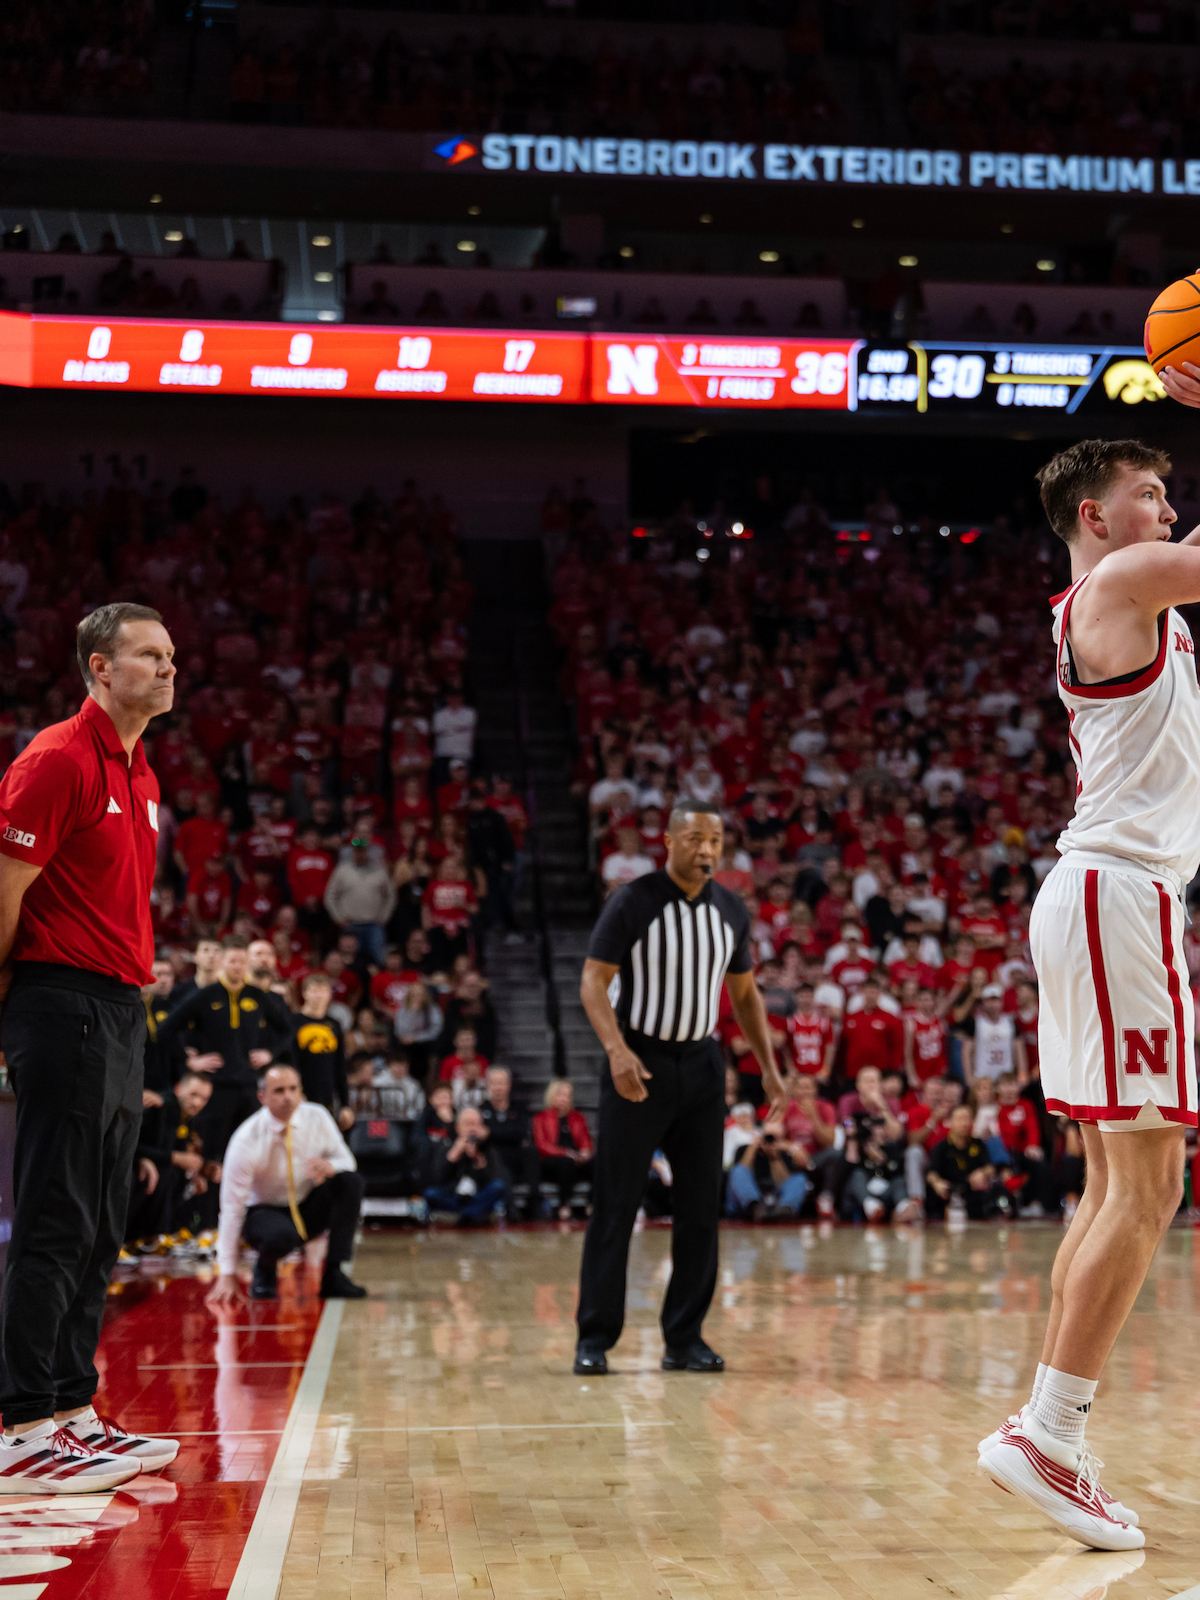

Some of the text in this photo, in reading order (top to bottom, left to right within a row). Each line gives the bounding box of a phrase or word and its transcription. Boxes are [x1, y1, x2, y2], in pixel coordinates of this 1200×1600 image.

[482, 132, 757, 179] STONEBROOK
[763, 143, 961, 186] EXTERIOR
[969, 150, 1154, 193] PREMIUM
[87, 326, 112, 359] 0
[179, 330, 204, 362] 8
[288, 333, 313, 365] 9
[397, 336, 431, 369] 10
[503, 339, 535, 372] 17
[699, 344, 781, 368] TIMEOUTS
[63, 360, 130, 383] BLOCKS
[159, 363, 222, 386] STEALS
[607, 343, 658, 395] N
[791, 351, 847, 395] 36
[867, 349, 909, 373] 2ND
[1011, 352, 1093, 376] TIMEOUTS
[250, 366, 348, 390] TURNOVERS
[374, 369, 448, 393] ASSISTS
[473, 372, 563, 396] REBOUNDS
[706, 376, 775, 400] 1 FOULS
[928, 353, 986, 399] 30
[1014, 383, 1070, 408] FOULS
[1121, 1027, 1170, 1076] N
